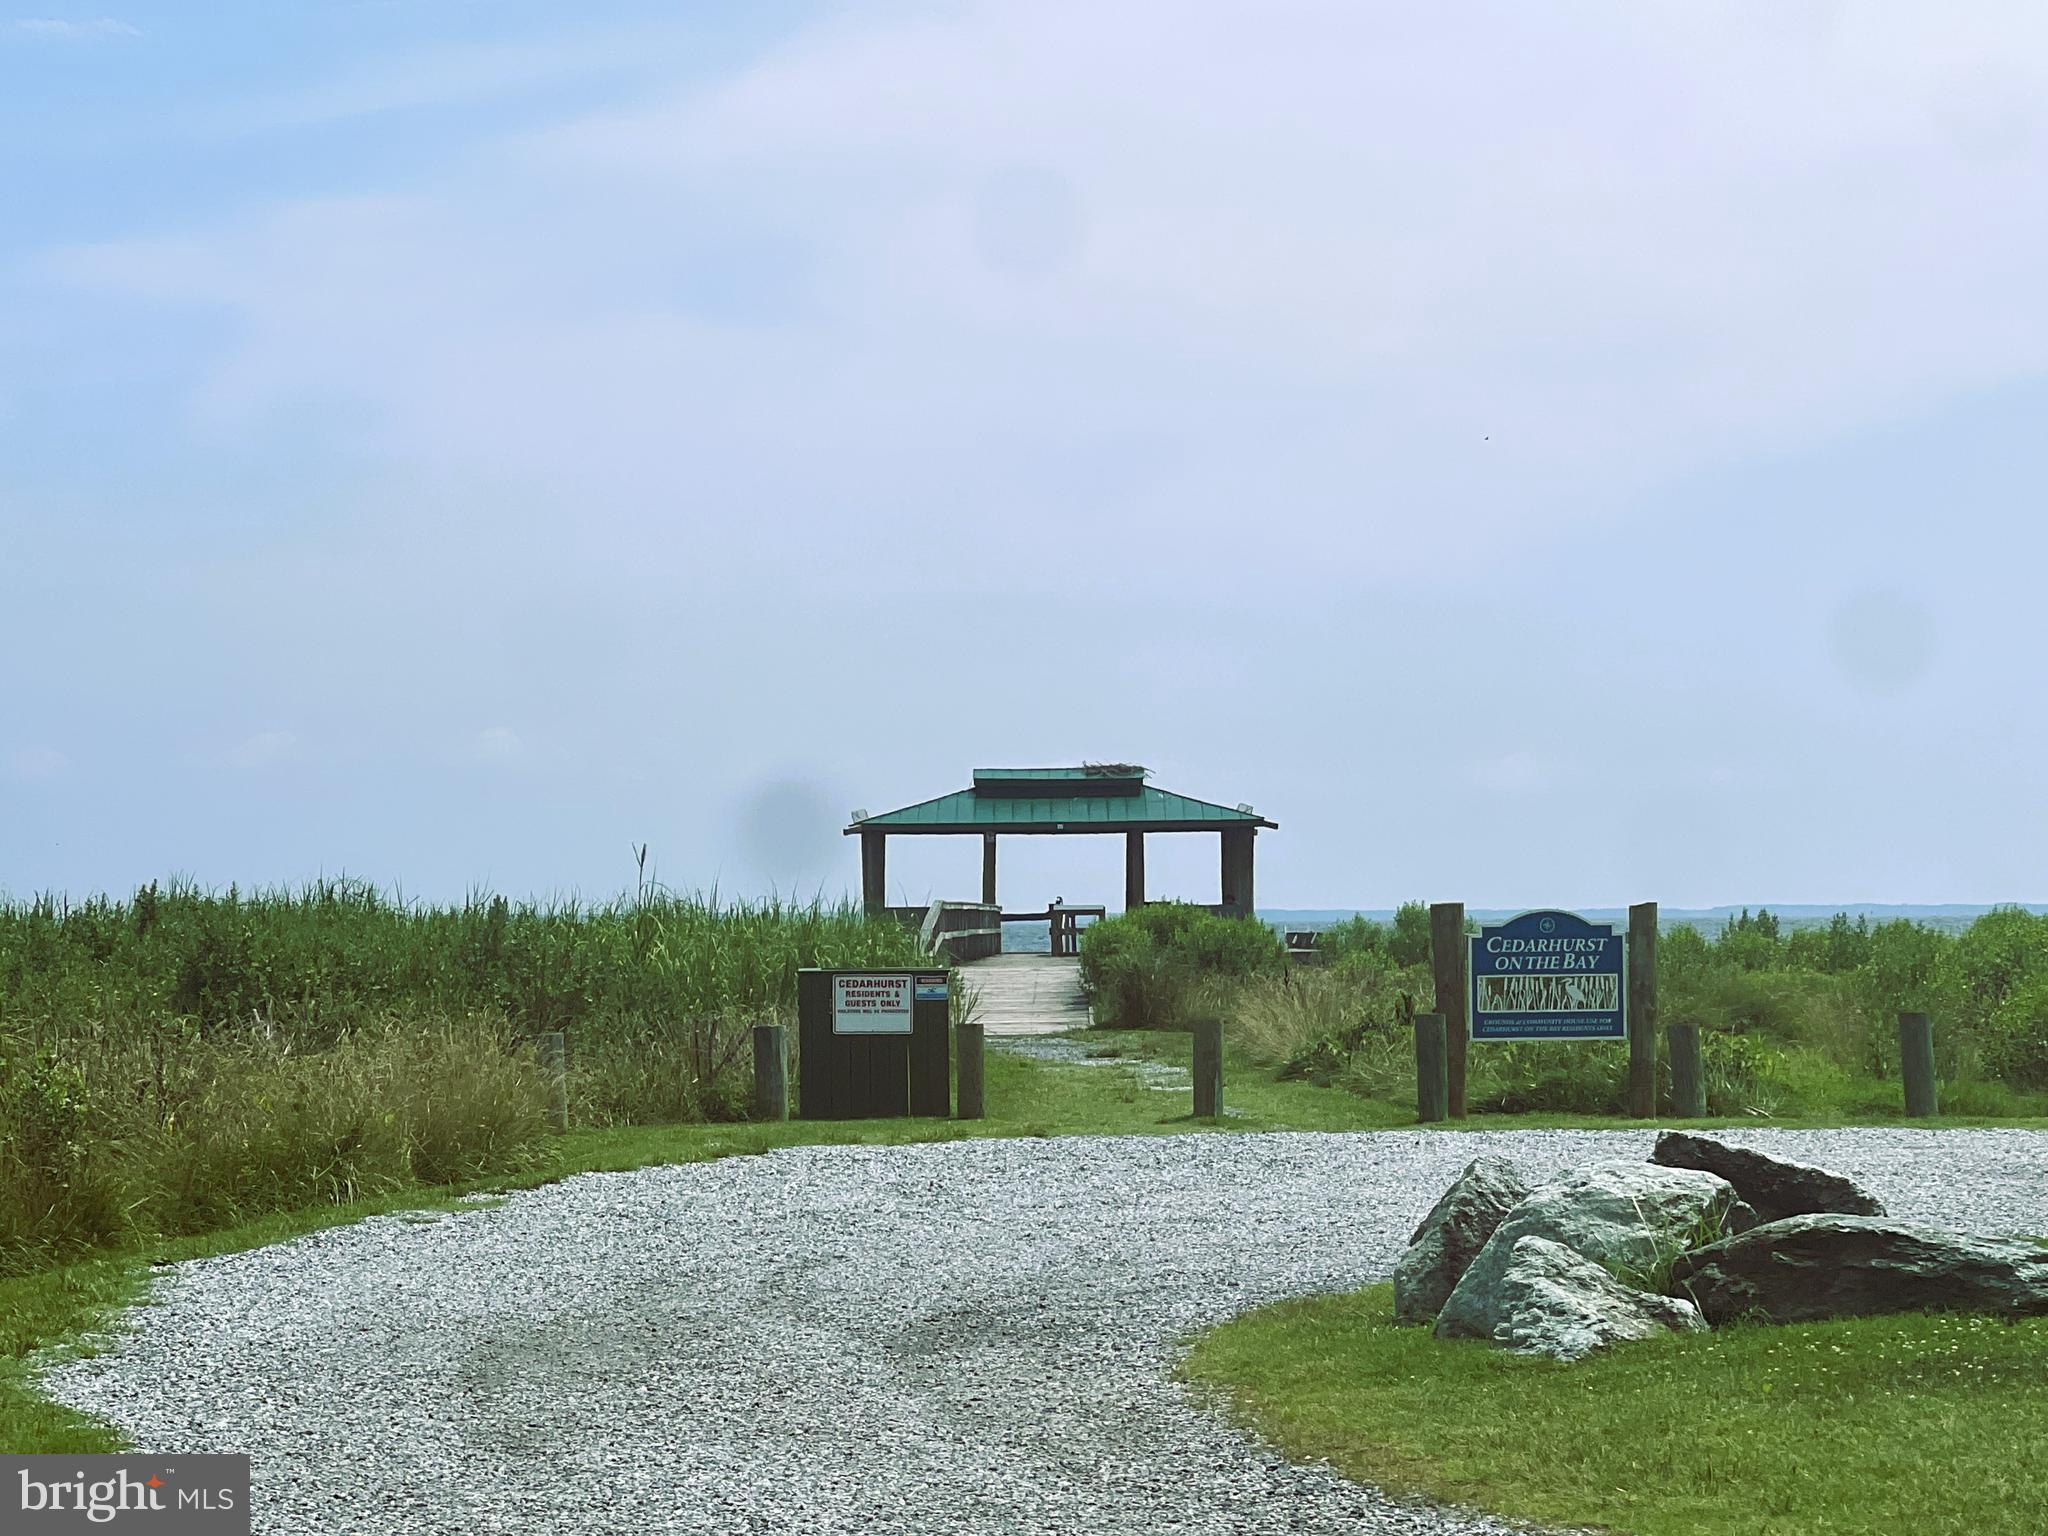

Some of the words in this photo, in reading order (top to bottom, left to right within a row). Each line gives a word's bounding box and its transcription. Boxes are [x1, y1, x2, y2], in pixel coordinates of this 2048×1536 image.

[1486, 936, 1608, 953] CEDARHURST
[1495, 956, 1523, 970] ON
[1525, 955, 1560, 970] THE
[1563, 953, 1600, 970] BAY
[839, 979, 908, 988] CEDARHURST
